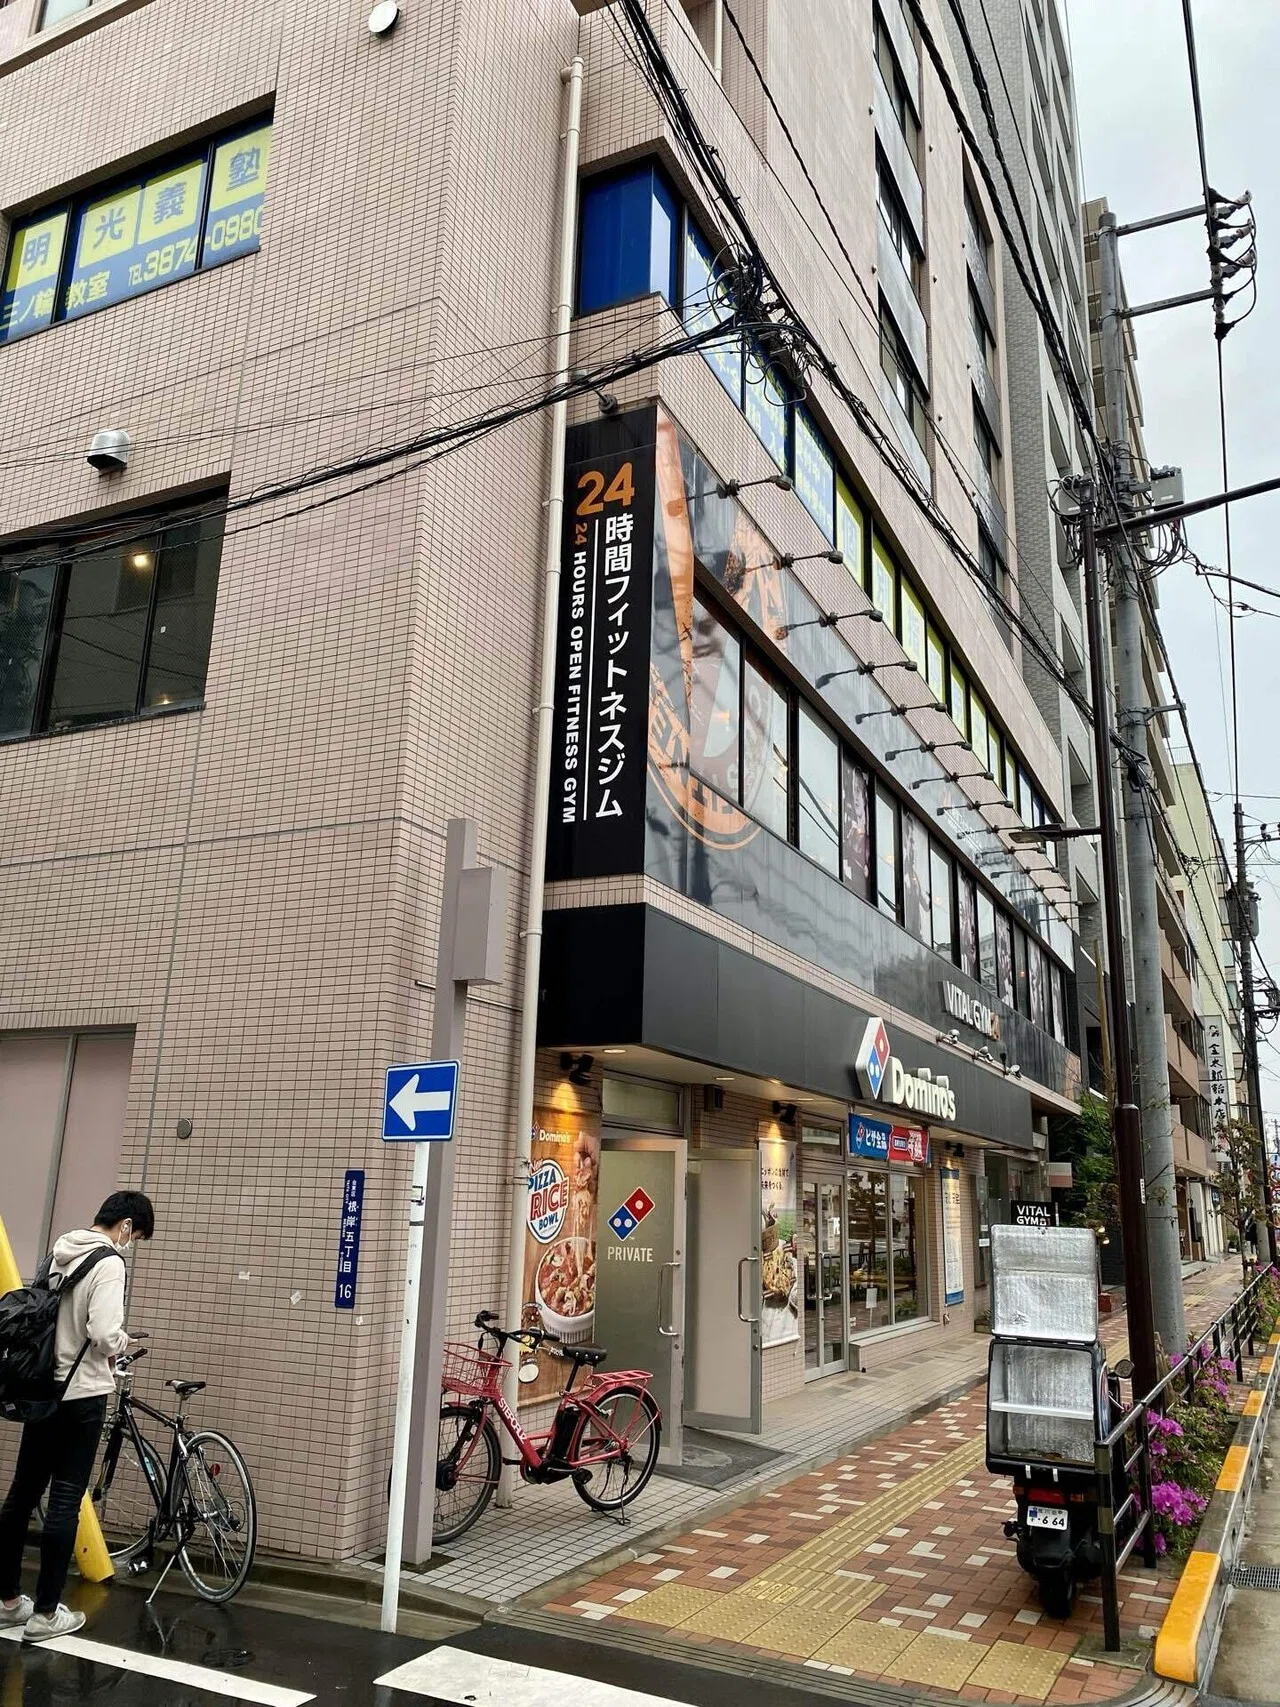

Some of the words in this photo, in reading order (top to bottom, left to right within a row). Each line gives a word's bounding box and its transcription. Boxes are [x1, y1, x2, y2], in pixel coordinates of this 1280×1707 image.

[23, 147, 261, 275] 明光義塾
[574, 523, 588, 546] 24
[571, 551, 587, 620] HOURS
[568, 625, 584, 680] OPEN
[595, 512, 635, 820] 時間フィットネスジム
[564, 685, 581, 771] FITNESS
[562, 777, 578, 824] GYM
[943, 980, 974, 1026] VITAL
[885, 1056, 957, 1122] Domino's
[540, 1129, 571, 1144] Domino's
[527, 1168, 557, 1193] PIZZA
[530, 1179, 568, 1221] RICE
[538, 1202, 559, 1231] BOWL
[1016, 1204, 1051, 1217] VITAL
[343, 1200, 358, 1273] 根岸五丁目
[607, 1246, 654, 1262] PRIVATE
[339, 1283, 352, 1299] 16
